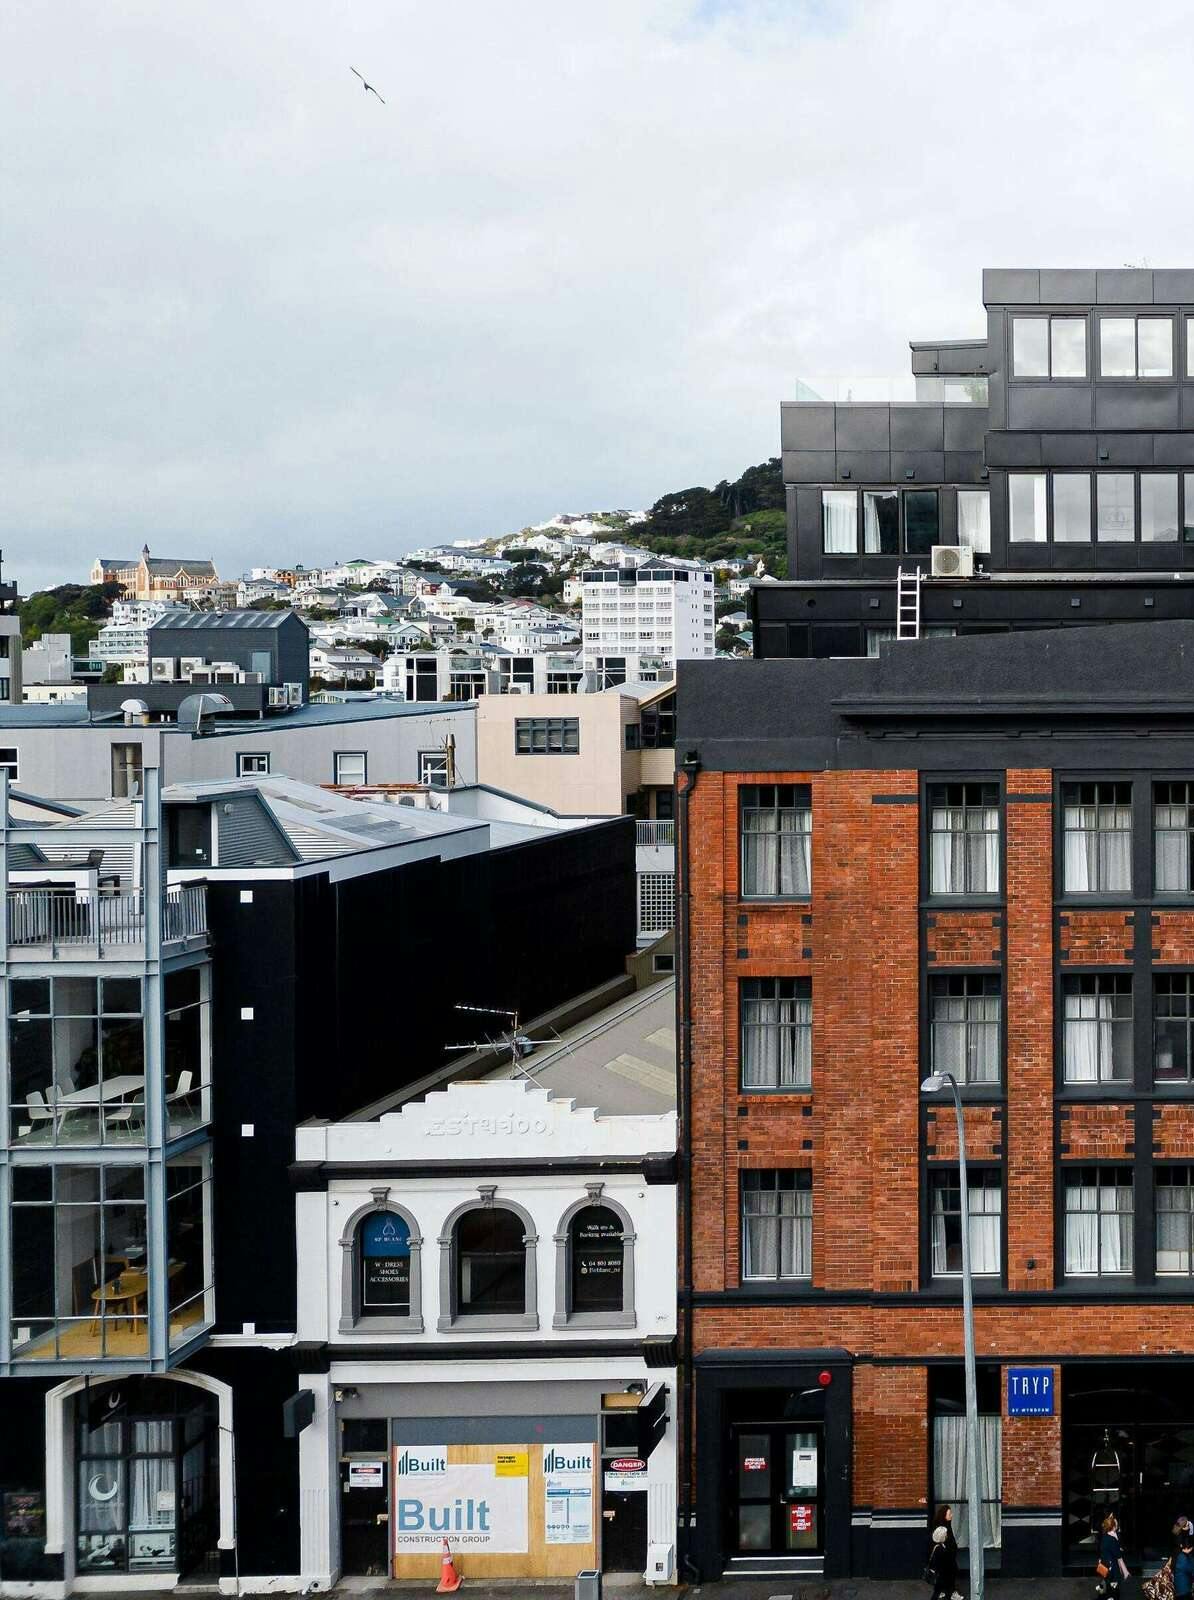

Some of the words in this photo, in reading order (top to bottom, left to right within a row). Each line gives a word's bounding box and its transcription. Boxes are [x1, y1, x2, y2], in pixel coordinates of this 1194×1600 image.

[1012, 1376, 1049, 1395] TRYP
[409, 1458, 445, 1471] Built
[555, 1456, 591, 1469] Built
[398, 1499, 490, 1531] Built
[462, 1535, 491, 1543] GROUP
